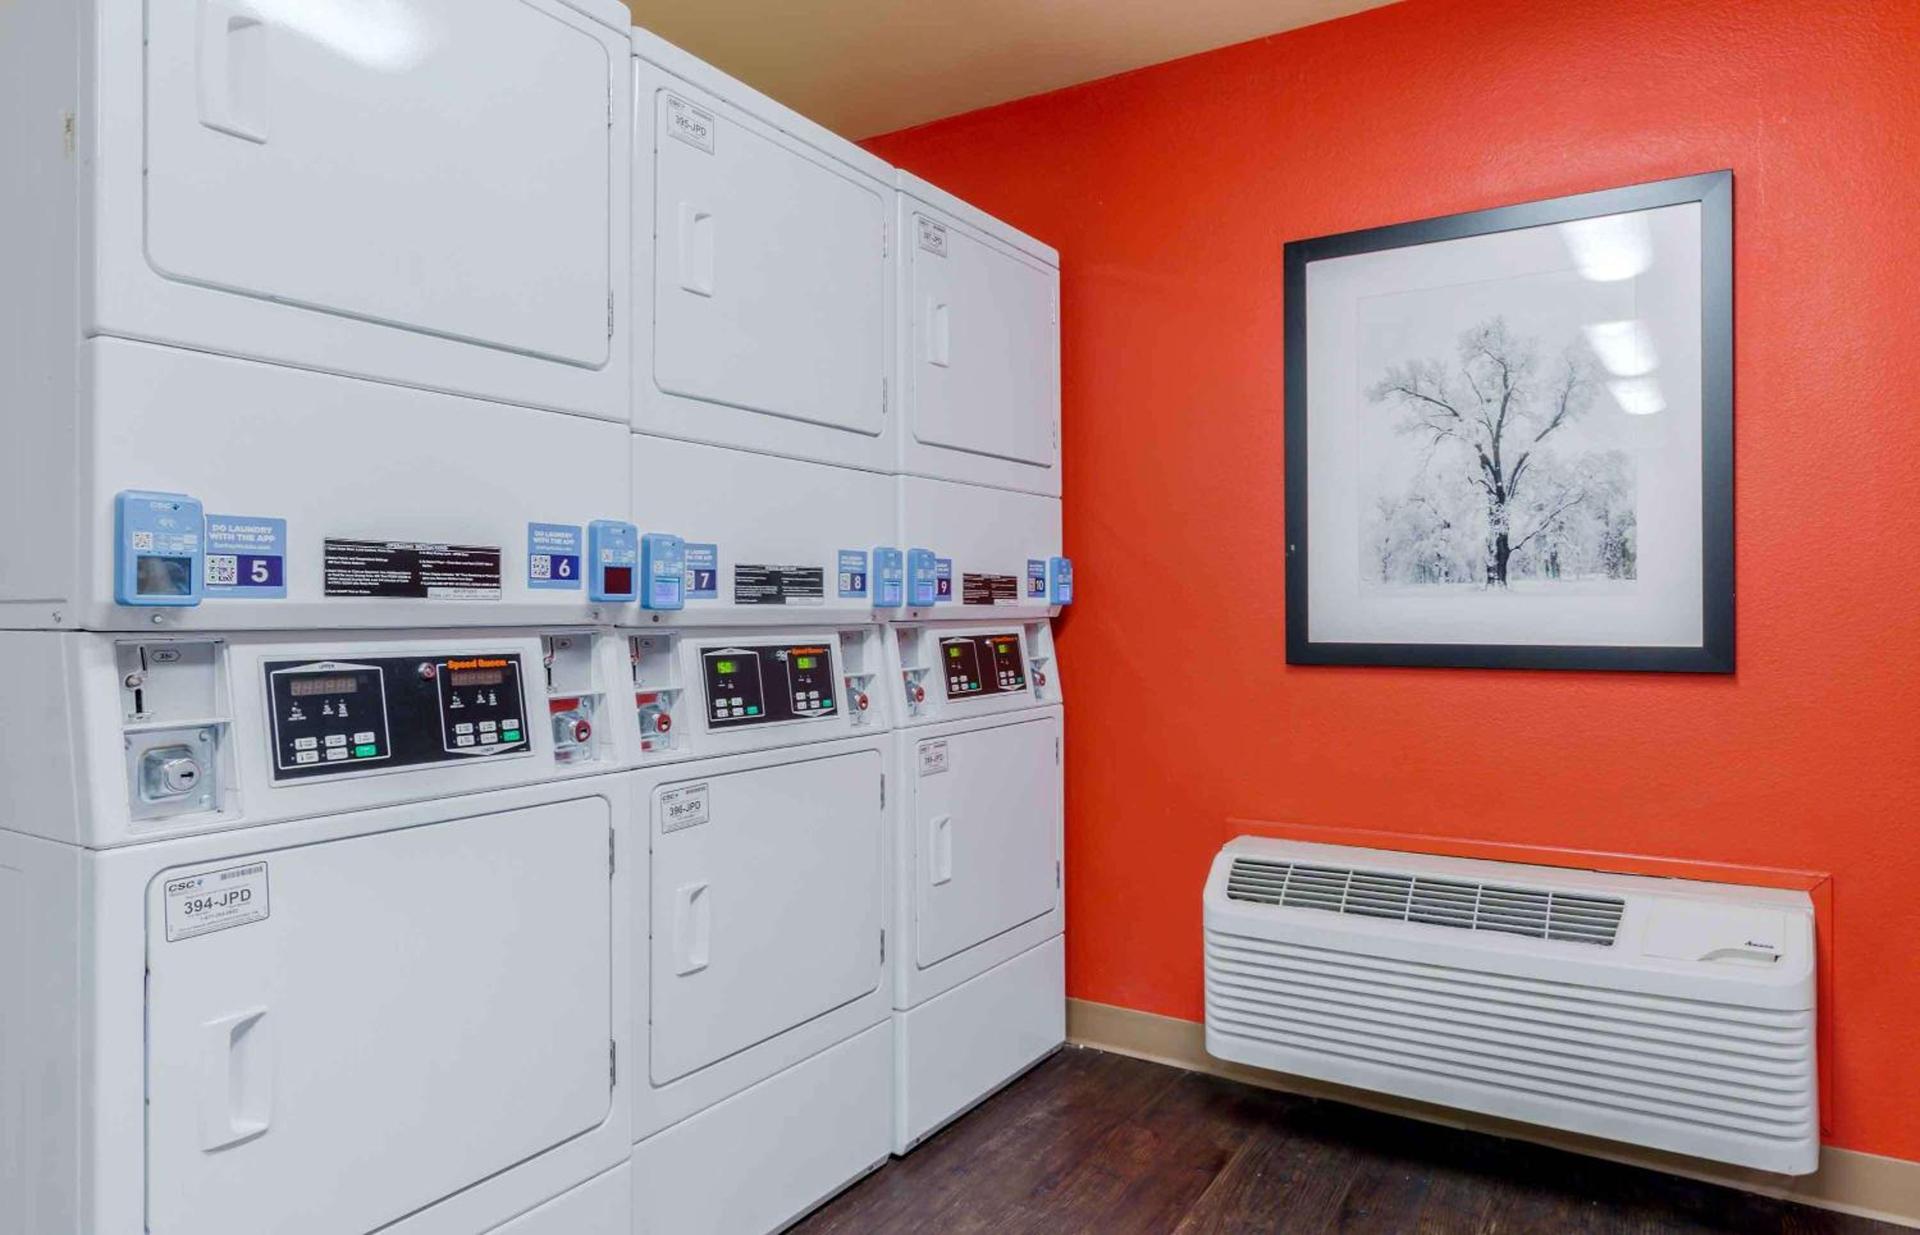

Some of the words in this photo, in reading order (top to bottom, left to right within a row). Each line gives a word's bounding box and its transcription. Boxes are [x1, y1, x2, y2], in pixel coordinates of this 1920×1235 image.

[228, 525, 272, 534] LAUNDRY
[208, 532, 235, 541] WITH
[256, 535, 275, 543] APP
[251, 560, 269, 583] 5
[559, 558, 571, 577] 6
[700, 573, 709, 588] 7
[855, 575, 861, 589] 8
[941, 581, 947, 593] 9
[1036, 580, 1044, 591] 10
[447, 659, 477, 671] Speed
[478, 658, 509, 669] Queen
[168, 880, 195, 892] CSC
[183, 888, 252, 915] 394-JPD
